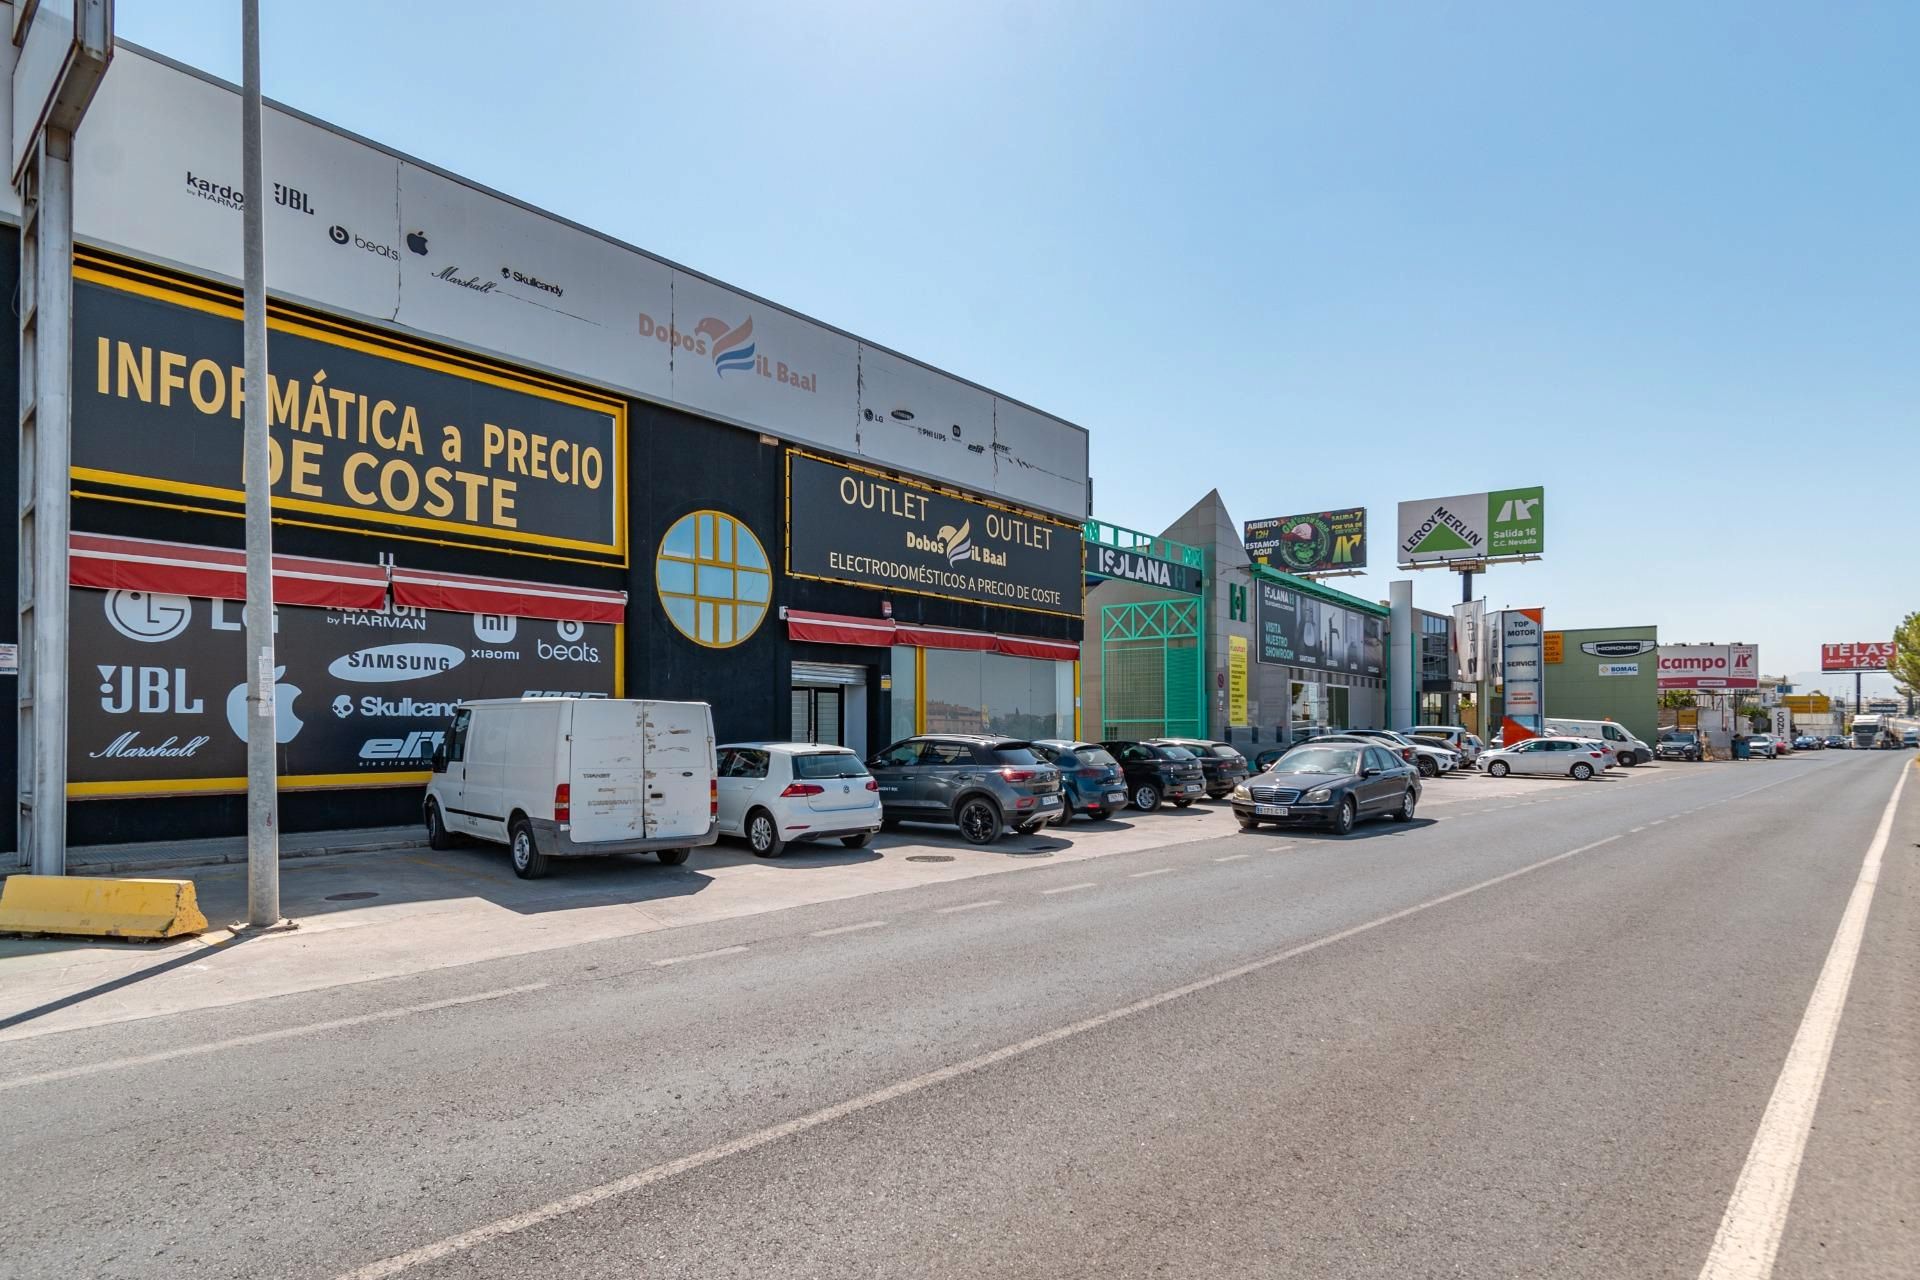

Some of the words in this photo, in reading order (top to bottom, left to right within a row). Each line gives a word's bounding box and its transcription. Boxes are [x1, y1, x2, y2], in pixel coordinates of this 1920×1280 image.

[186, 171, 244, 203] kardo
[273, 182, 314, 215] JBL
[198, 190, 245, 211] HARMA
[431, 266, 496, 294] Marshall
[513, 271, 564, 297] Skullcandy
[639, 312, 706, 355] Dobos
[776, 361, 817, 393] Baal
[442, 425, 462, 463] a
[484, 423, 603, 490] PRECIO
[343, 451, 518, 529] COSTE
[840, 476, 930, 522] OUTLET
[986, 514, 1053, 551] OUTLET
[1247, 519, 1278, 530] ABIERTO
[1402, 515, 1439, 553] LEROY
[1434, 506, 1482, 546] MERLIN
[1493, 528, 1523, 539] Salida
[1525, 527, 1537, 536] 16
[906, 531, 945, 555] Dobos
[983, 548, 1007, 567] Baal
[1245, 540, 1279, 550] ESTAMOS
[1508, 538, 1537, 546] Nevada
[830, 552, 966, 592] ELECTRODOMÉSTICOS
[968, 577, 976, 592] A
[978, 578, 1015, 599] PRECIO
[1017, 585, 1030, 601] DE
[1031, 587, 1061, 606] COSTE
[327, 616, 340, 625] by
[343, 614, 426, 630] HARMAN
[1265, 621, 1281, 634] VISITA
[1507, 629, 1536, 637] MOTOR
[1265, 633, 1288, 647] NUESTRO
[1825, 643, 1894, 657] TELAS
[348, 651, 450, 671] SAMSUNG
[1265, 646, 1294, 661] SHOWROOM
[1657, 654, 1727, 672] lcampo
[97, 665, 204, 714] JBL
[361, 696, 463, 717] Skullcand
[89, 731, 209, 758] Marshall
